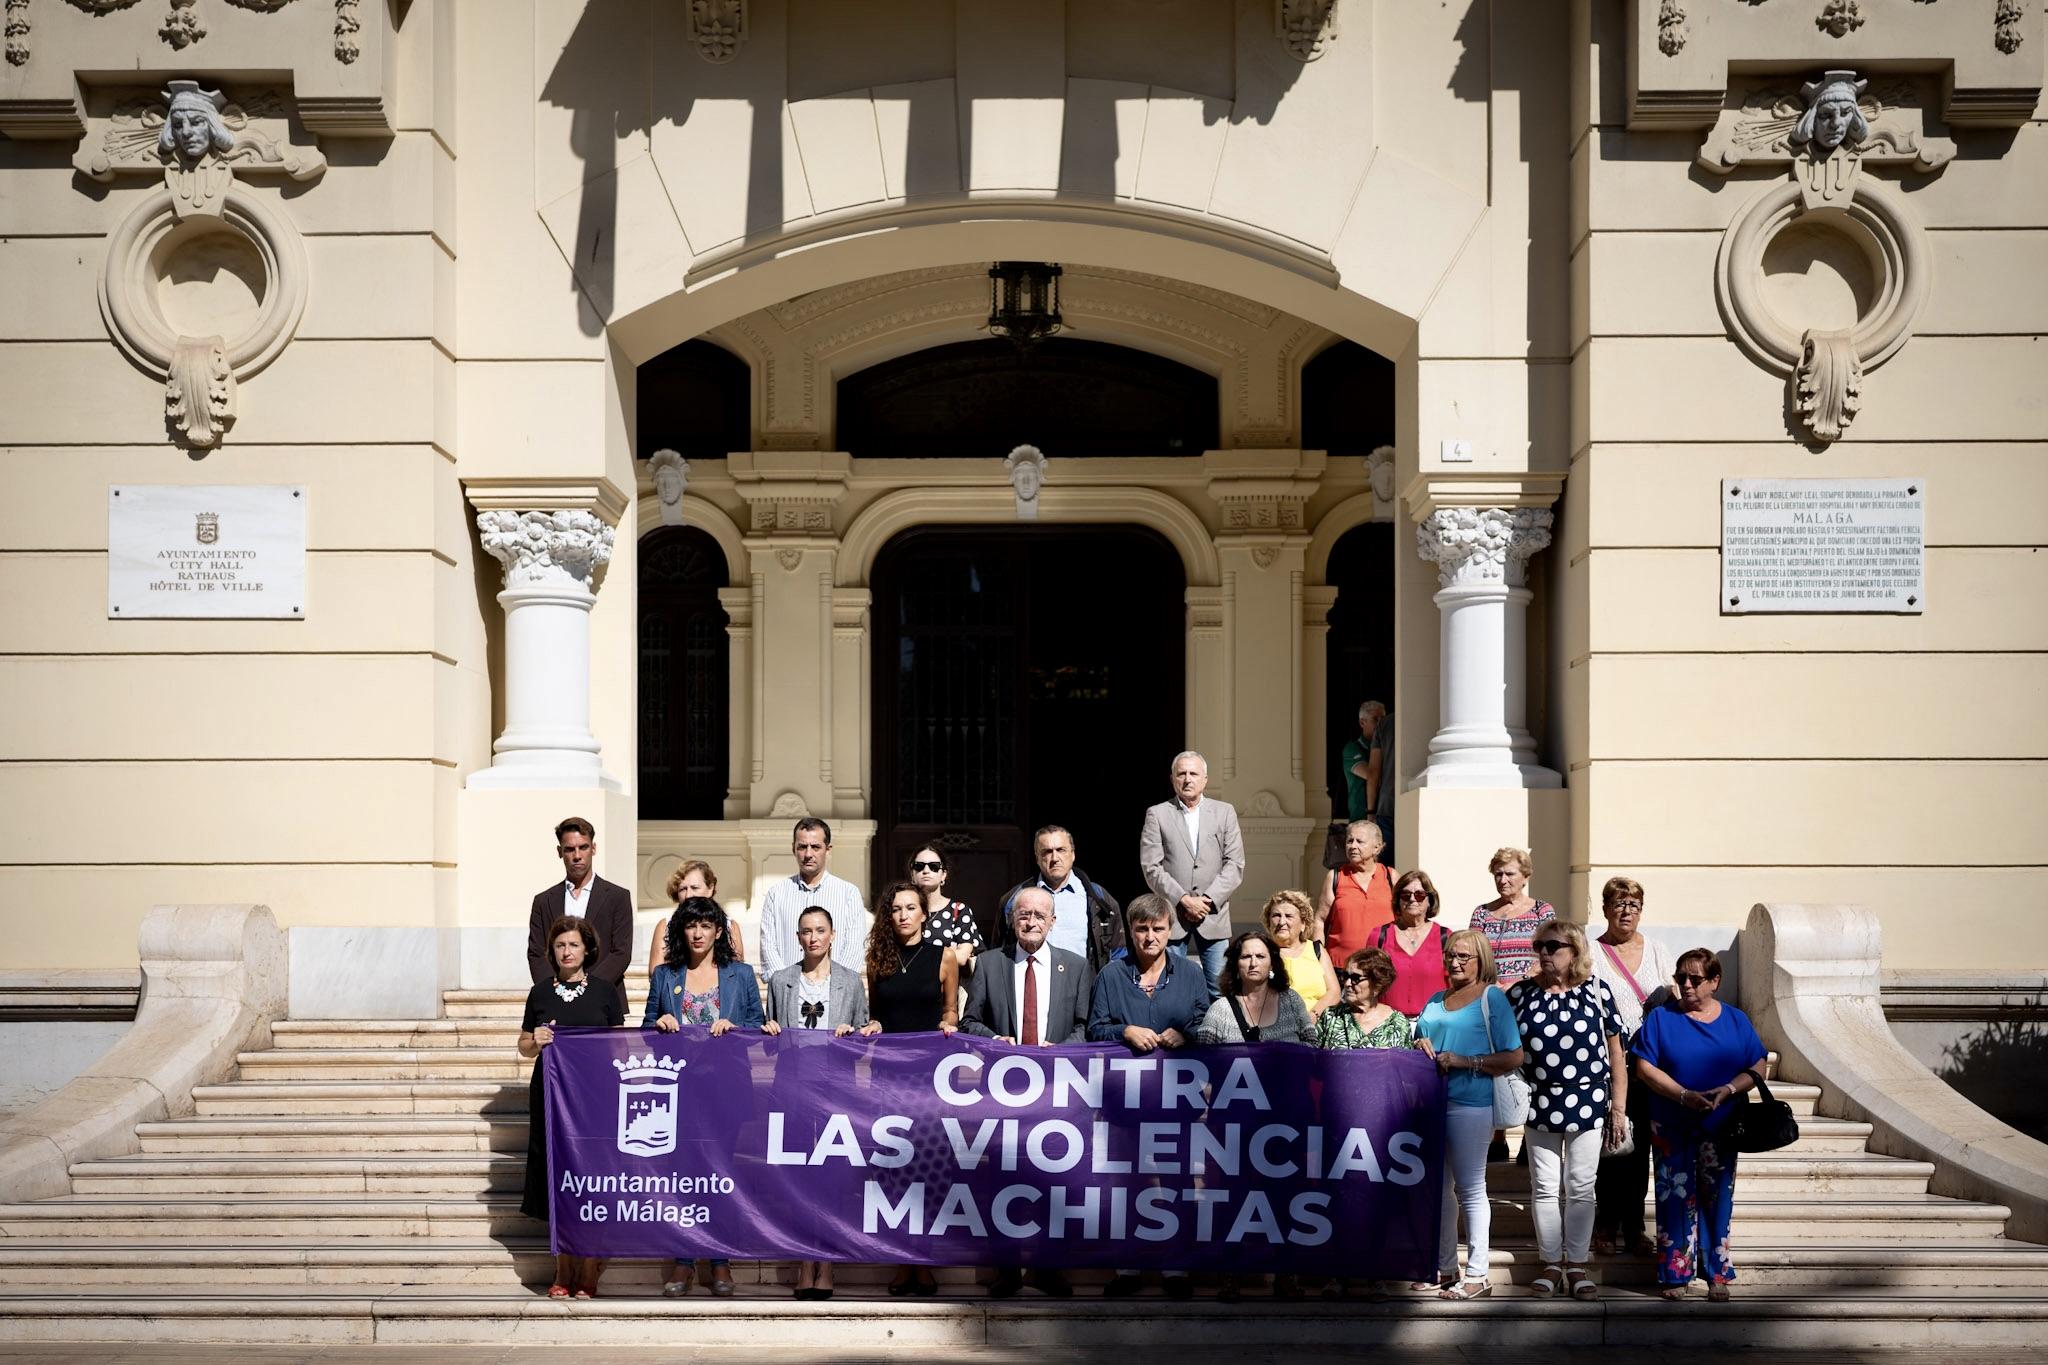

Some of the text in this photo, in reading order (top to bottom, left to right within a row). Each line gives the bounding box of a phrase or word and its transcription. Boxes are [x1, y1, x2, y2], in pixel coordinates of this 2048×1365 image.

[1454, 442, 1462, 457] 4
[1744, 491, 1751, 499] LA
[1754, 491, 1767, 499] MUY
[1770, 491, 1788, 499] NOBLE
[1790, 491, 1802, 499] MUY
[1805, 491, 1818, 499] LEAL
[1820, 491, 1844, 499] SIEMPRE
[1874, 491, 1881, 499] LA
[1882, 491, 1906, 499] PRIMERA
[1727, 502, 1734, 510] EN
[1736, 502, 1742, 510] EL
[1744, 502, 1764, 510] PELIGRO
[1766, 502, 1772, 510] DE
[1773, 502, 1780, 510] LA
[1781, 502, 1805, 510] LIBERTAD
[1807, 502, 1818, 510] MUY
[1860, 502, 1871, 510] MUY
[1915, 502, 1920, 510] DE
[1727, 526, 1736, 534] FUE
[1738, 526, 1745, 534] EN
[1746, 526, 1753, 534] SU
[1754, 526, 1774, 534] ORIGEN
[1775, 526, 1782, 534] UN
[1783, 526, 1806, 534] POBLADO
[157, 550, 256, 559] AYUNTAMIENTO
[170, 561, 244, 570] CITY HALL
[178, 572, 236, 580] RATHAUS
[150, 581, 264, 591] HÔTEL DE VILLE
[933, 1052, 1272, 1112] CONTRA
[766, 1112, 1426, 1186] LAS VIOLENCIAS
[560, 1170, 735, 1198] Ayuntamiento
[579, 1200, 710, 1228] de Málaga
[863, 1182, 1334, 1246] MACHISTAS
